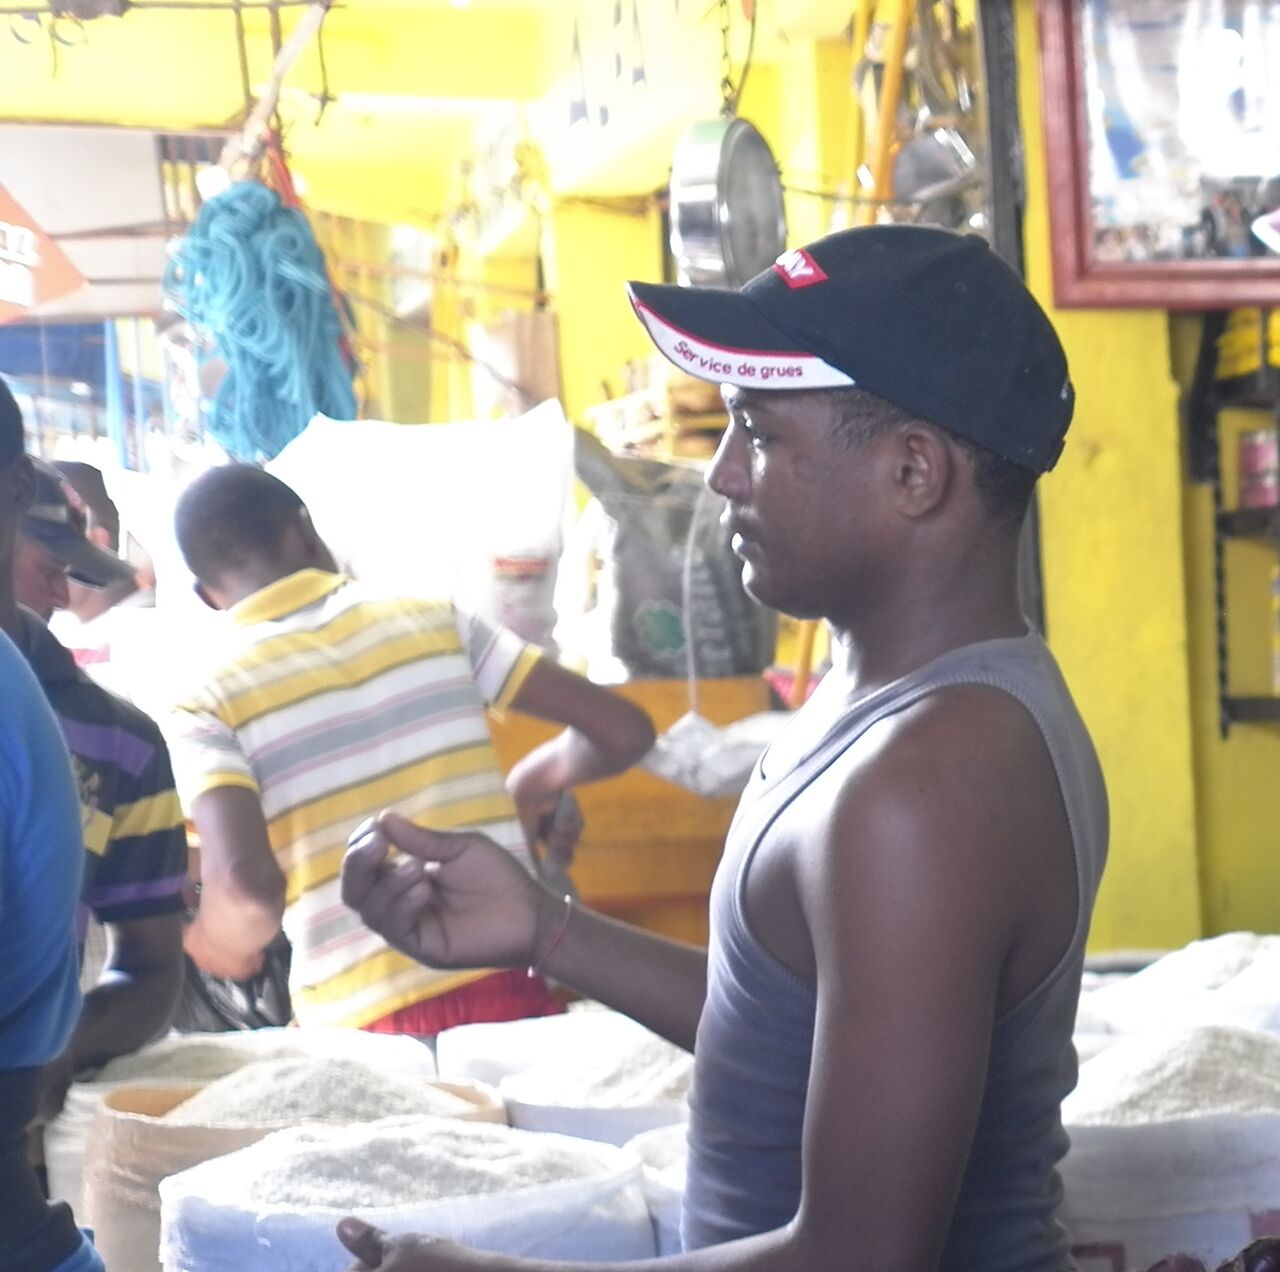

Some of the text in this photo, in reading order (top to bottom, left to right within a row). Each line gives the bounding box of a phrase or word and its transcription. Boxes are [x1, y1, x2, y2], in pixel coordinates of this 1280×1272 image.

[673, 340, 804, 379] Service de grues
